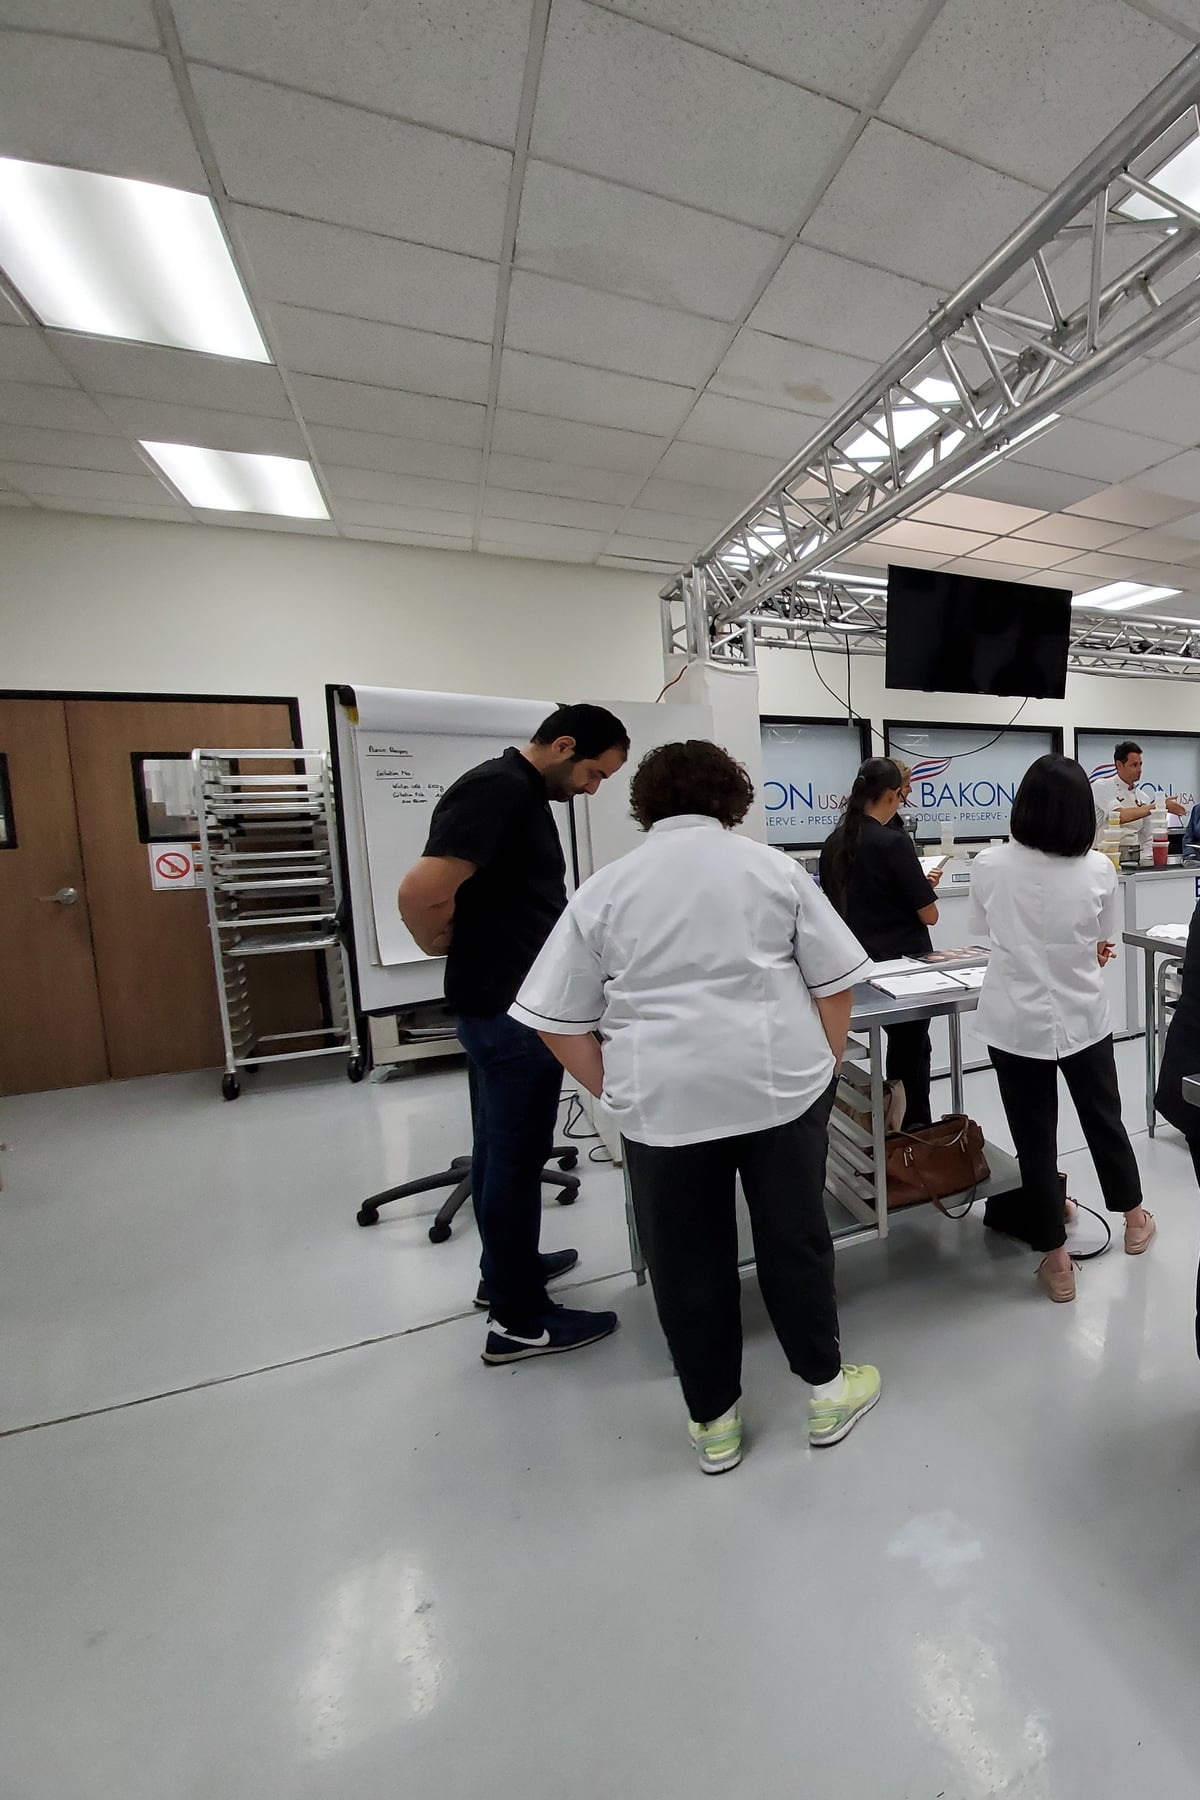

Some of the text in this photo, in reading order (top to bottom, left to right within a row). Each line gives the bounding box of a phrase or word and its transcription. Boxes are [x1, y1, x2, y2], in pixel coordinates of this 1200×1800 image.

[818, 794, 848, 810] USA
[921, 781, 1016, 807] BAKON
[960, 811, 1002, 821] PRESERVE
